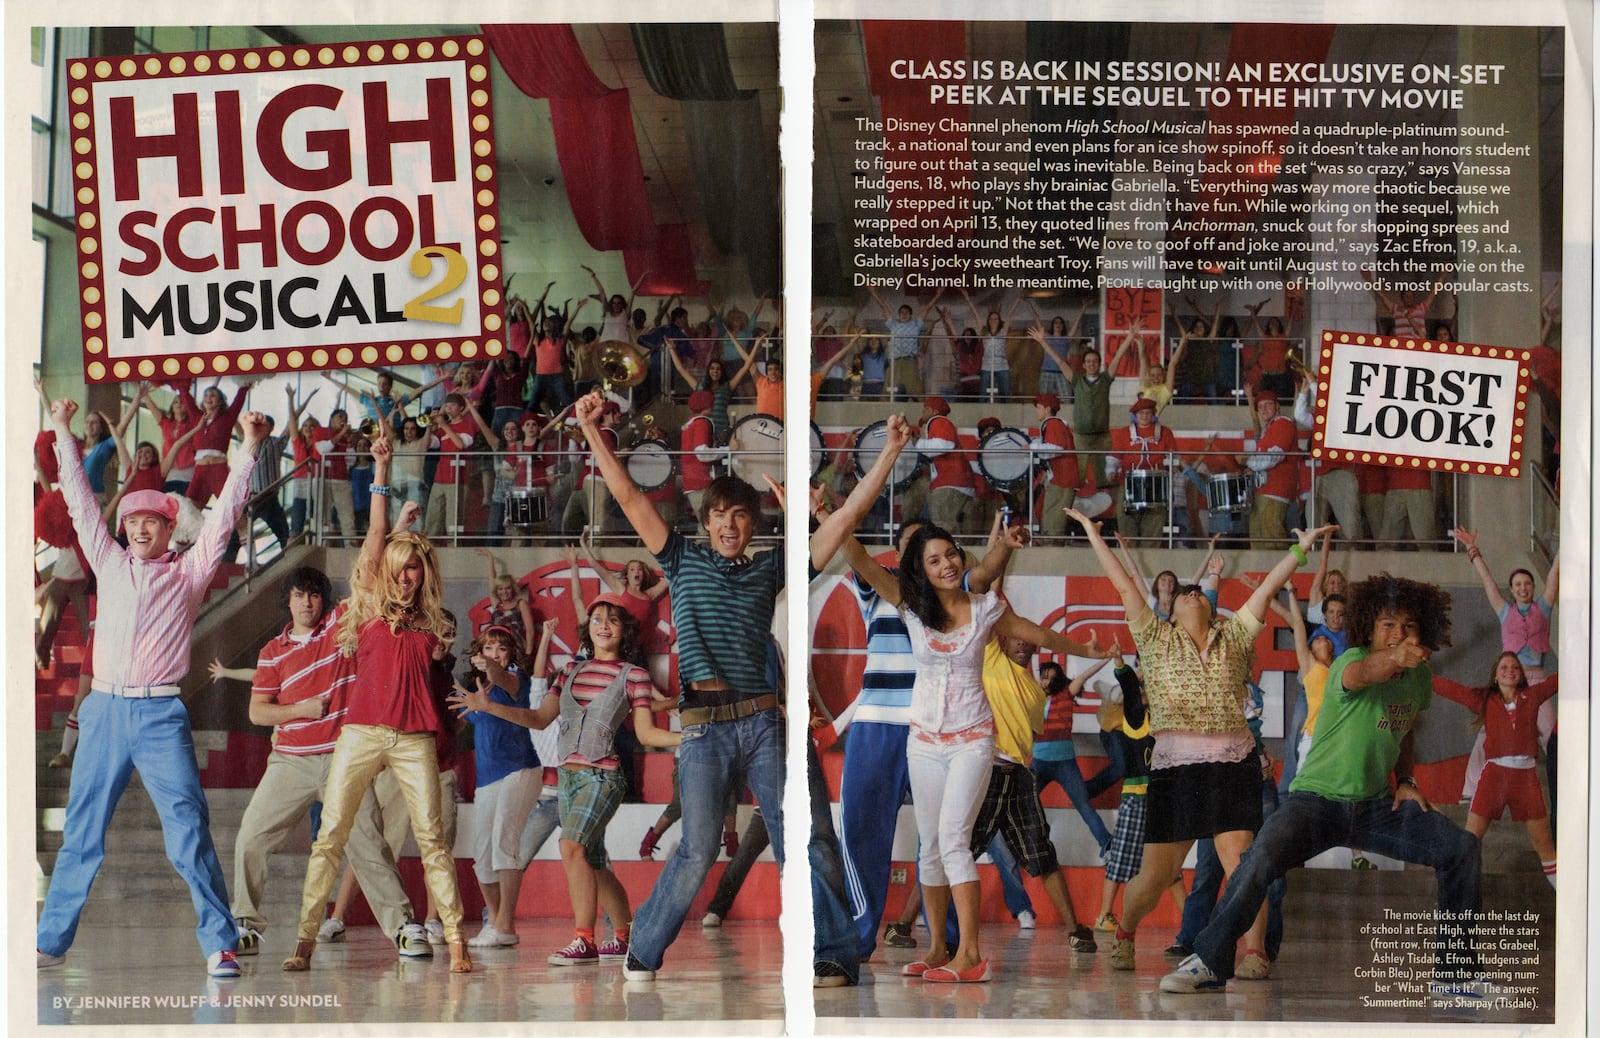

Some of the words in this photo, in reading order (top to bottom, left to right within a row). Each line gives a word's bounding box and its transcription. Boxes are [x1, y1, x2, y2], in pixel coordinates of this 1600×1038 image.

[890, 59, 966, 79] CLASS
[973, 60, 994, 80] IS
[1000, 60, 1068, 80] BACK
[1075, 61, 1100, 80] IN
[1106, 61, 1220, 82] SESSION!
[1225, 62, 1261, 82] AN
[1269, 62, 1404, 83] EXCLUSIVE
[1411, 63, 1505, 84] ON-SET
[930, 84, 993, 104] PEEK
[998, 85, 1031, 105] AT
[1036, 85, 1086, 105] THE
[1092, 86, 1190, 106] SEQUEL
[1195, 86, 1230, 106] TO
[1236, 87, 1286, 107] THE
[1294, 88, 1336, 108] HIT
[1341, 88, 1376, 108] TV
[1381, 88, 1463, 109] MOVIE
[109, 77, 457, 202] HIGH
[854, 117, 883, 131] The
[886, 117, 936, 135] Disney
[939, 117, 1000, 132] Channel
[1002, 118, 1062, 136] phenom
[1065, 118, 1099, 136] High
[1101, 119, 1150, 133] School
[1152, 119, 1206, 134] Musical
[1208, 120, 1232, 134] has
[1236, 120, 1299, 138] spawned
[1302, 125, 1310, 135] a
[1314, 121, 1457, 140] quadruple-platinum
[1460, 122, 1509, 136] sound-
[854, 175, 922, 193] Hudgens,
[926, 176, 946, 190] 18,
[950, 176, 980, 190] who
[984, 176, 1020, 194] plays
[1023, 177, 1048, 194] shy
[1051, 177, 1108, 191] brainiac
[1111, 178, 1179, 192] Gabriella.
[1271, 183, 1298, 193] was
[1300, 184, 1329, 196] way
[1332, 184, 1370, 193] more
[1373, 180, 1426, 194] chaotic
[1428, 180, 1487, 194] because
[1490, 185, 1510, 194] we
[118, 194, 462, 276] SCHOOL
[853, 214, 917, 232] wrapped
[920, 219, 939, 228] on
[942, 214, 977, 232] April
[981, 215, 1001, 231] 13,
[1005, 216, 1038, 233] they
[1040, 216, 1093, 234] quoted
[1097, 216, 1130, 230] lines
[1134, 217, 1168, 230] from
[1171, 217, 1258, 233] Anchorman,
[1262, 218, 1304, 232] snuck
[1308, 221, 1332, 232] out
[1336, 218, 1357, 232] for
[1360, 219, 1428, 236] shopping
[1432, 223, 1478, 237] sprees
[1482, 220, 1509, 233] and
[930, 253, 971, 271] jocky
[974, 254, 1054, 268] sweetheart
[1057, 255, 1092, 272] Troy.
[1096, 256, 1128, 269] Fans
[1132, 256, 1155, 269] will
[1160, 256, 1194, 269] have
[1197, 258, 1212, 270] to
[1215, 257, 1246, 270] wait
[1249, 256, 1282, 270] until
[1285, 257, 1338, 274] August
[1342, 260, 1356, 271] to
[1360, 257, 1399, 275] catch
[1402, 258, 1427, 272] the
[1430, 259, 1475, 272] movie
[1478, 263, 1497, 272] on
[1501, 259, 1524, 272] the
[122, 272, 407, 339] MUSICAL
[402, 245, 468, 325] 2
[854, 273, 903, 290] Disney
[906, 273, 969, 287] Channel.
[974, 274, 986, 287] In
[990, 274, 1014, 287] the
[1017, 274, 1093, 290] meantime,
[1097, 275, 1144, 289] PEOPLE
[1147, 274, 1197, 293] caught
[1200, 280, 1218, 293] up
[1221, 276, 1252, 289] with
[1256, 280, 1283, 290] one
[1286, 276, 1302, 290] of
[1394, 280, 1431, 291] most
[1434, 278, 1490, 295] popular
[1493, 280, 1532, 292] casts.
[1346, 361, 1502, 409] FIRST
[1342, 401, 1496, 449] LOOK!
[1383, 908, 1401, 920] The
[1403, 910, 1431, 920] movie
[1433, 908, 1456, 921] kicks
[1458, 908, 1472, 920] off
[1487, 909, 1502, 920] the
[1504, 910, 1521, 921] last
[1522, 909, 1540, 923] day
[1360, 923, 1371, 934] of
[1372, 923, 1402, 934] school
[1404, 925, 1414, 934] at
[1417, 923, 1437, 935] East
[1440, 923, 1465, 936] High,
[1468, 923, 1496, 935] where
[1498, 924, 1514, 935] the
[1516, 925, 1540, 935] stars
[1370, 937, 1398, 951] (front
[1400, 941, 1420, 949] row,
[1422, 938, 1446, 949] from
[1448, 938, 1467, 950] left,
[1470, 938, 1496, 950] Lucas
[1499, 938, 1539, 952] Grabeel,
[1372, 951, 1404, 966] Ashley
[1407, 952, 1443, 964] Tisdale,
[1446, 952, 1474, 964] Efron,
[1477, 952, 1519, 967] Hudgens
[1521, 953, 1539, 964] and
[1354, 966, 1386, 978] Corbin
[1389, 966, 1413, 980] Bleu)
[1416, 966, 1454, 981] perform
[1457, 967, 1473, 978] the
[1474, 968, 1512, 982] opening
[1515, 970, 1539, 980] num-
[1375, 981, 1391, 992] ber
[1426, 982, 1450, 993] Time
[1453, 982, 1461, 993] Is
[1482, 982, 1500, 994] The
[1503, 986, 1539, 994] answer:
[53, 996, 72, 1008] BY
[76, 996, 150, 1008] JENNIFER
[154, 996, 206, 1008] WULFF
[210, 996, 220, 1008] &
[224, 995, 276, 1007] JENNY
[280, 994, 341, 1007] SUNDEL
[1433, 995, 1453, 1010] says
[1455, 996, 1492, 1010] Sharpay
[1494, 996, 1538, 1011] (Tisdale).
